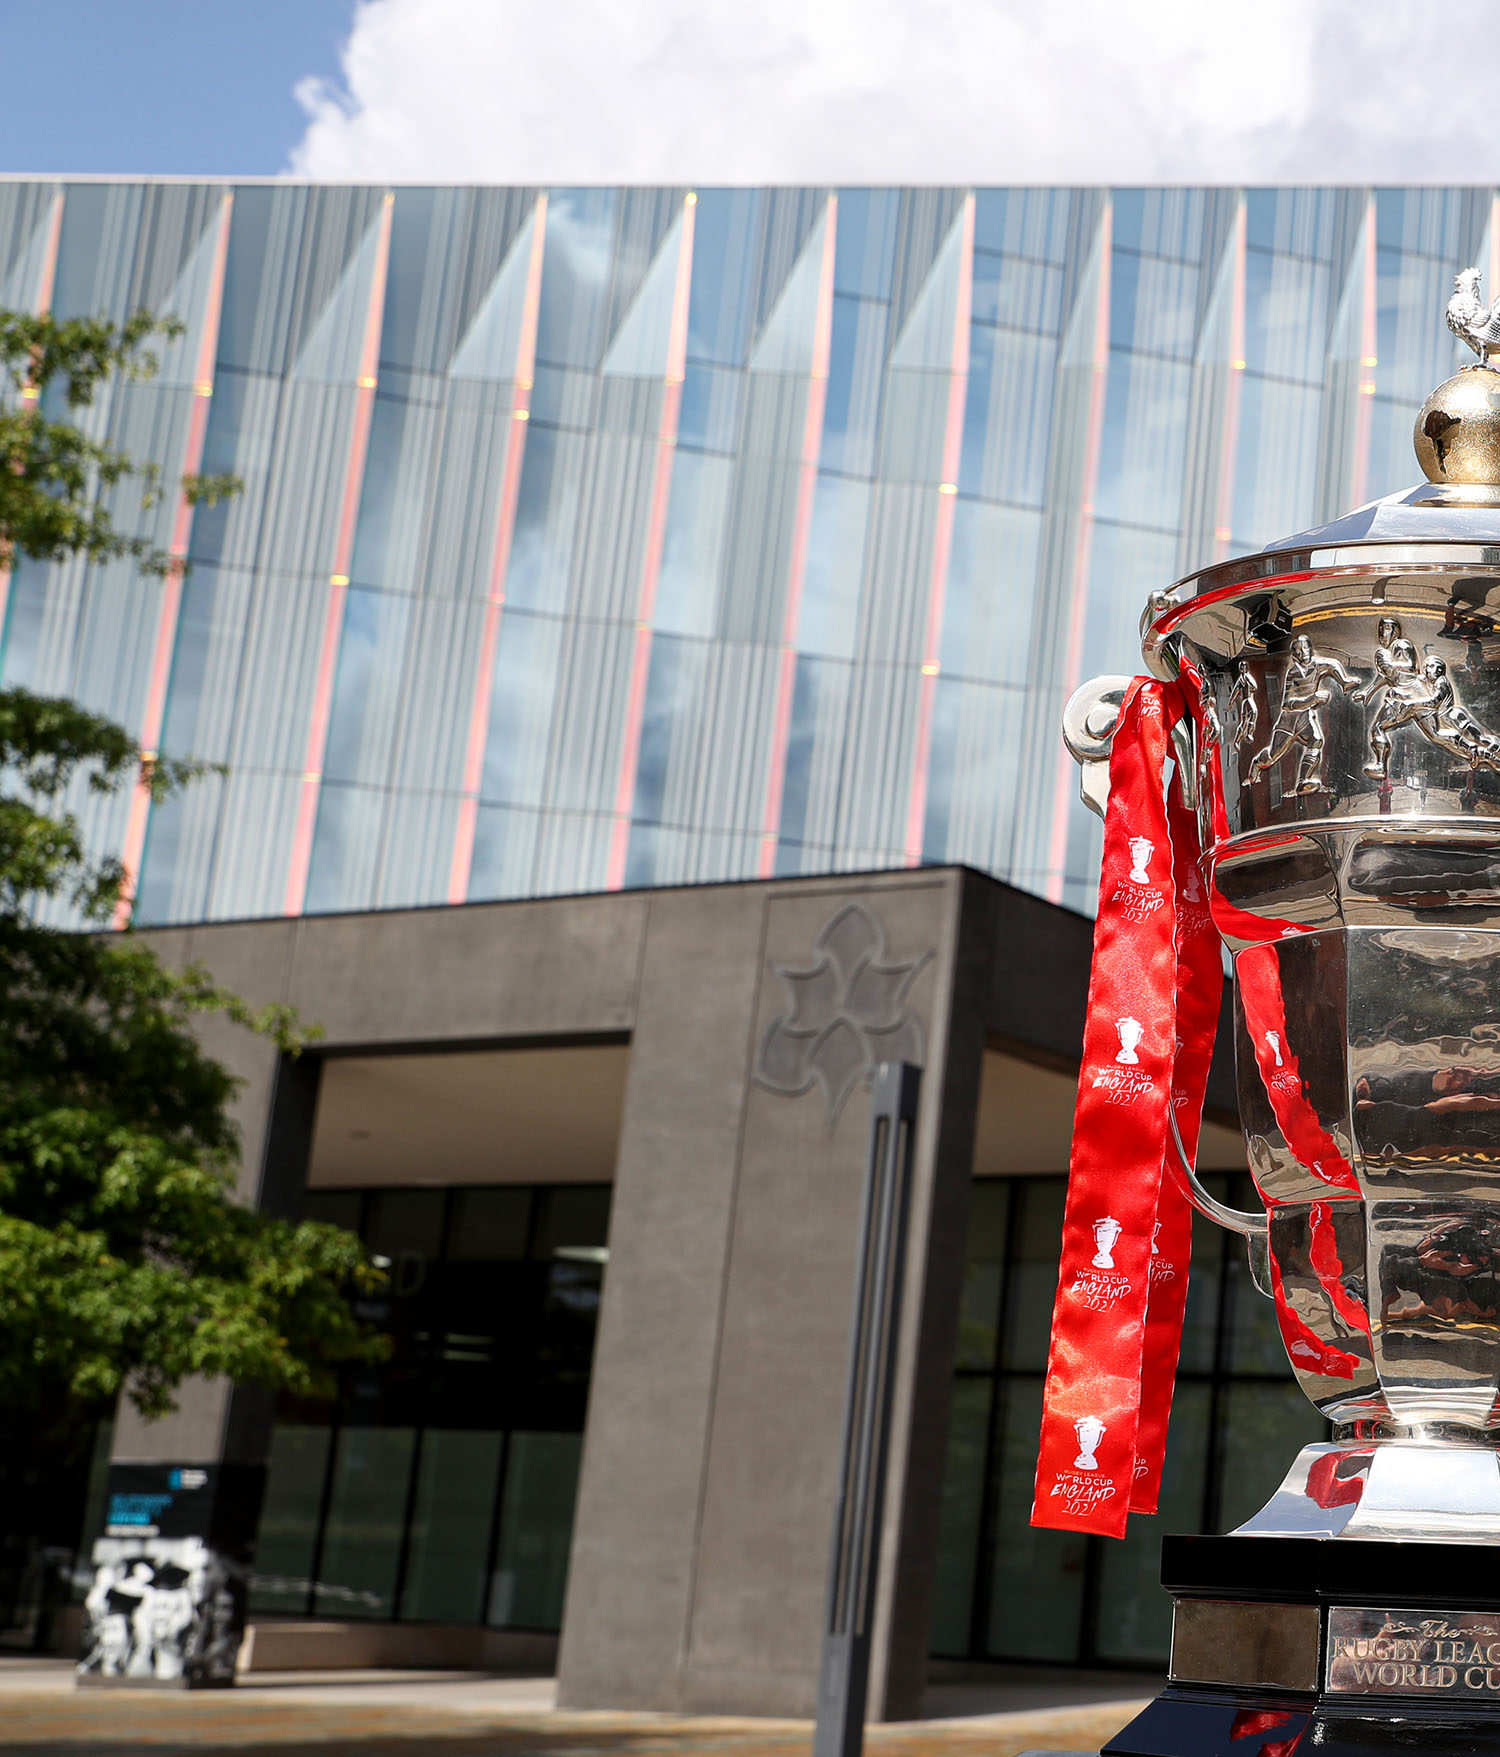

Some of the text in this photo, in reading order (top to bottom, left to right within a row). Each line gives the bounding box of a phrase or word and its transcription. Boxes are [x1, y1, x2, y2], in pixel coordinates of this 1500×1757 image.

[1092, 1076, 1154, 1094] ENGLAND
[1105, 1091, 1138, 1106] 2021
[1111, 1276, 1128, 1284] CUP
[1071, 1280, 1131, 1299] ENGLAND
[1083, 1296, 1115, 1312] 2021
[1094, 1478, 1113, 1486] CUP
[1050, 1483, 1116, 1502] ENGLAND
[1062, 1501, 1097, 1516] 2021
[1419, 1620, 1461, 1638] The
[1333, 1636, 1424, 1662] RUGBY
[1353, 1662, 1457, 1688] WORLD
